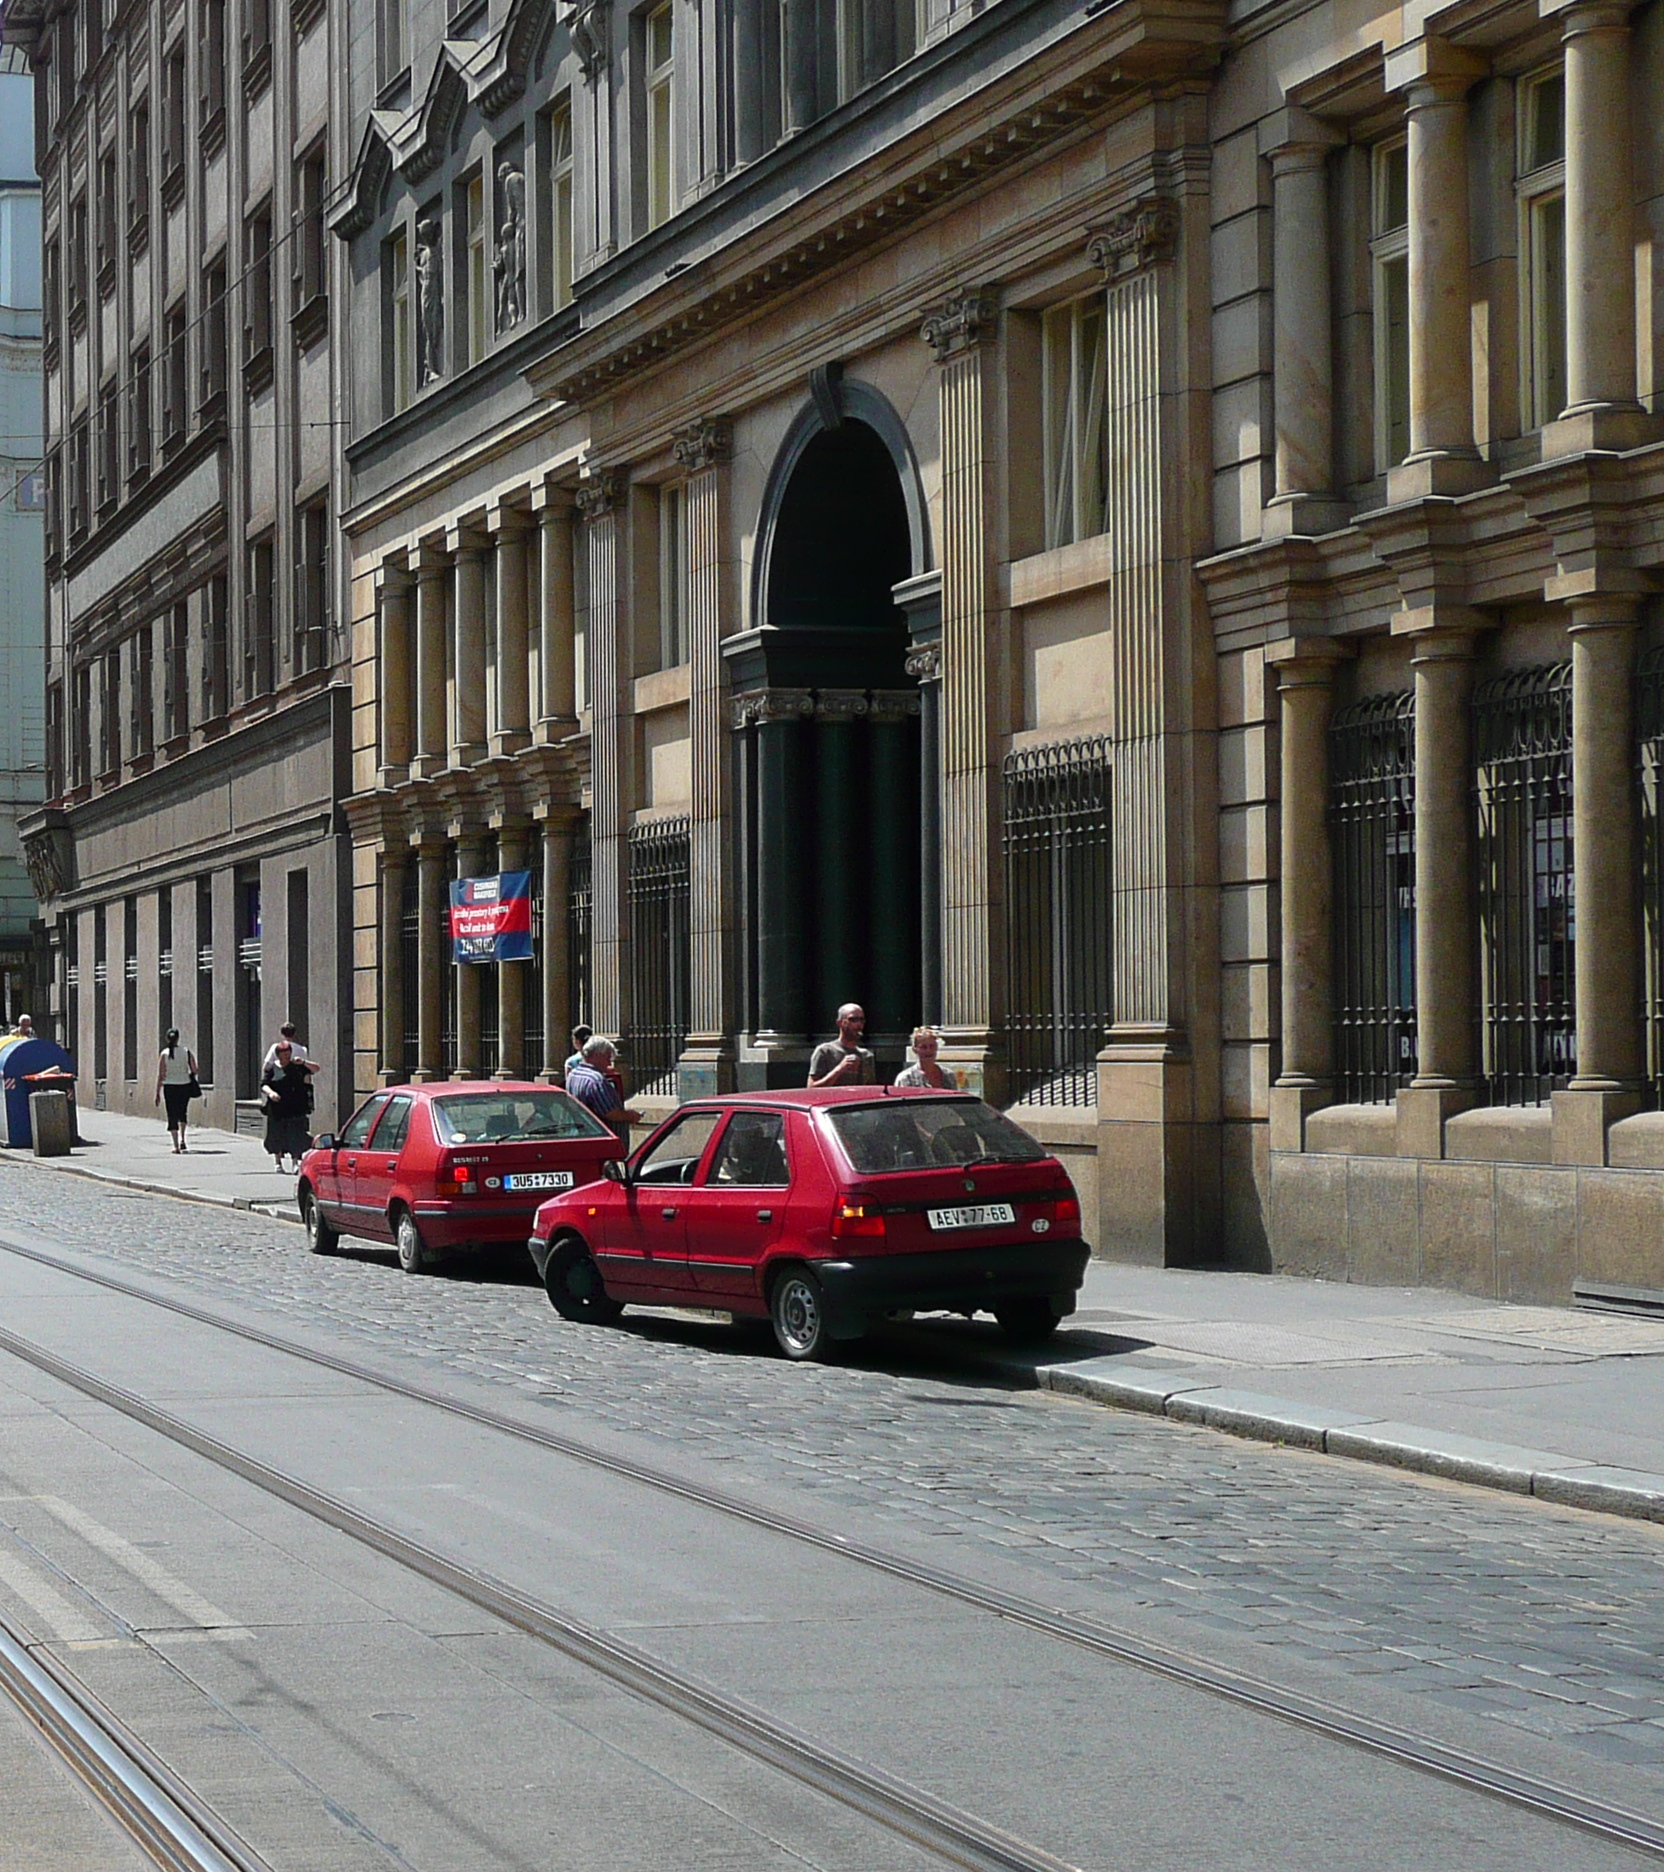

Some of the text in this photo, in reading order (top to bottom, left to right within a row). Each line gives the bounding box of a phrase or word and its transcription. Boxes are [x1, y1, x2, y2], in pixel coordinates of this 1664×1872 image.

[513, 1174, 568, 1187] 3U5 7330
[936, 1206, 1007, 1226] AEV 77-68
[1035, 1220, 1046, 1231] CZ
